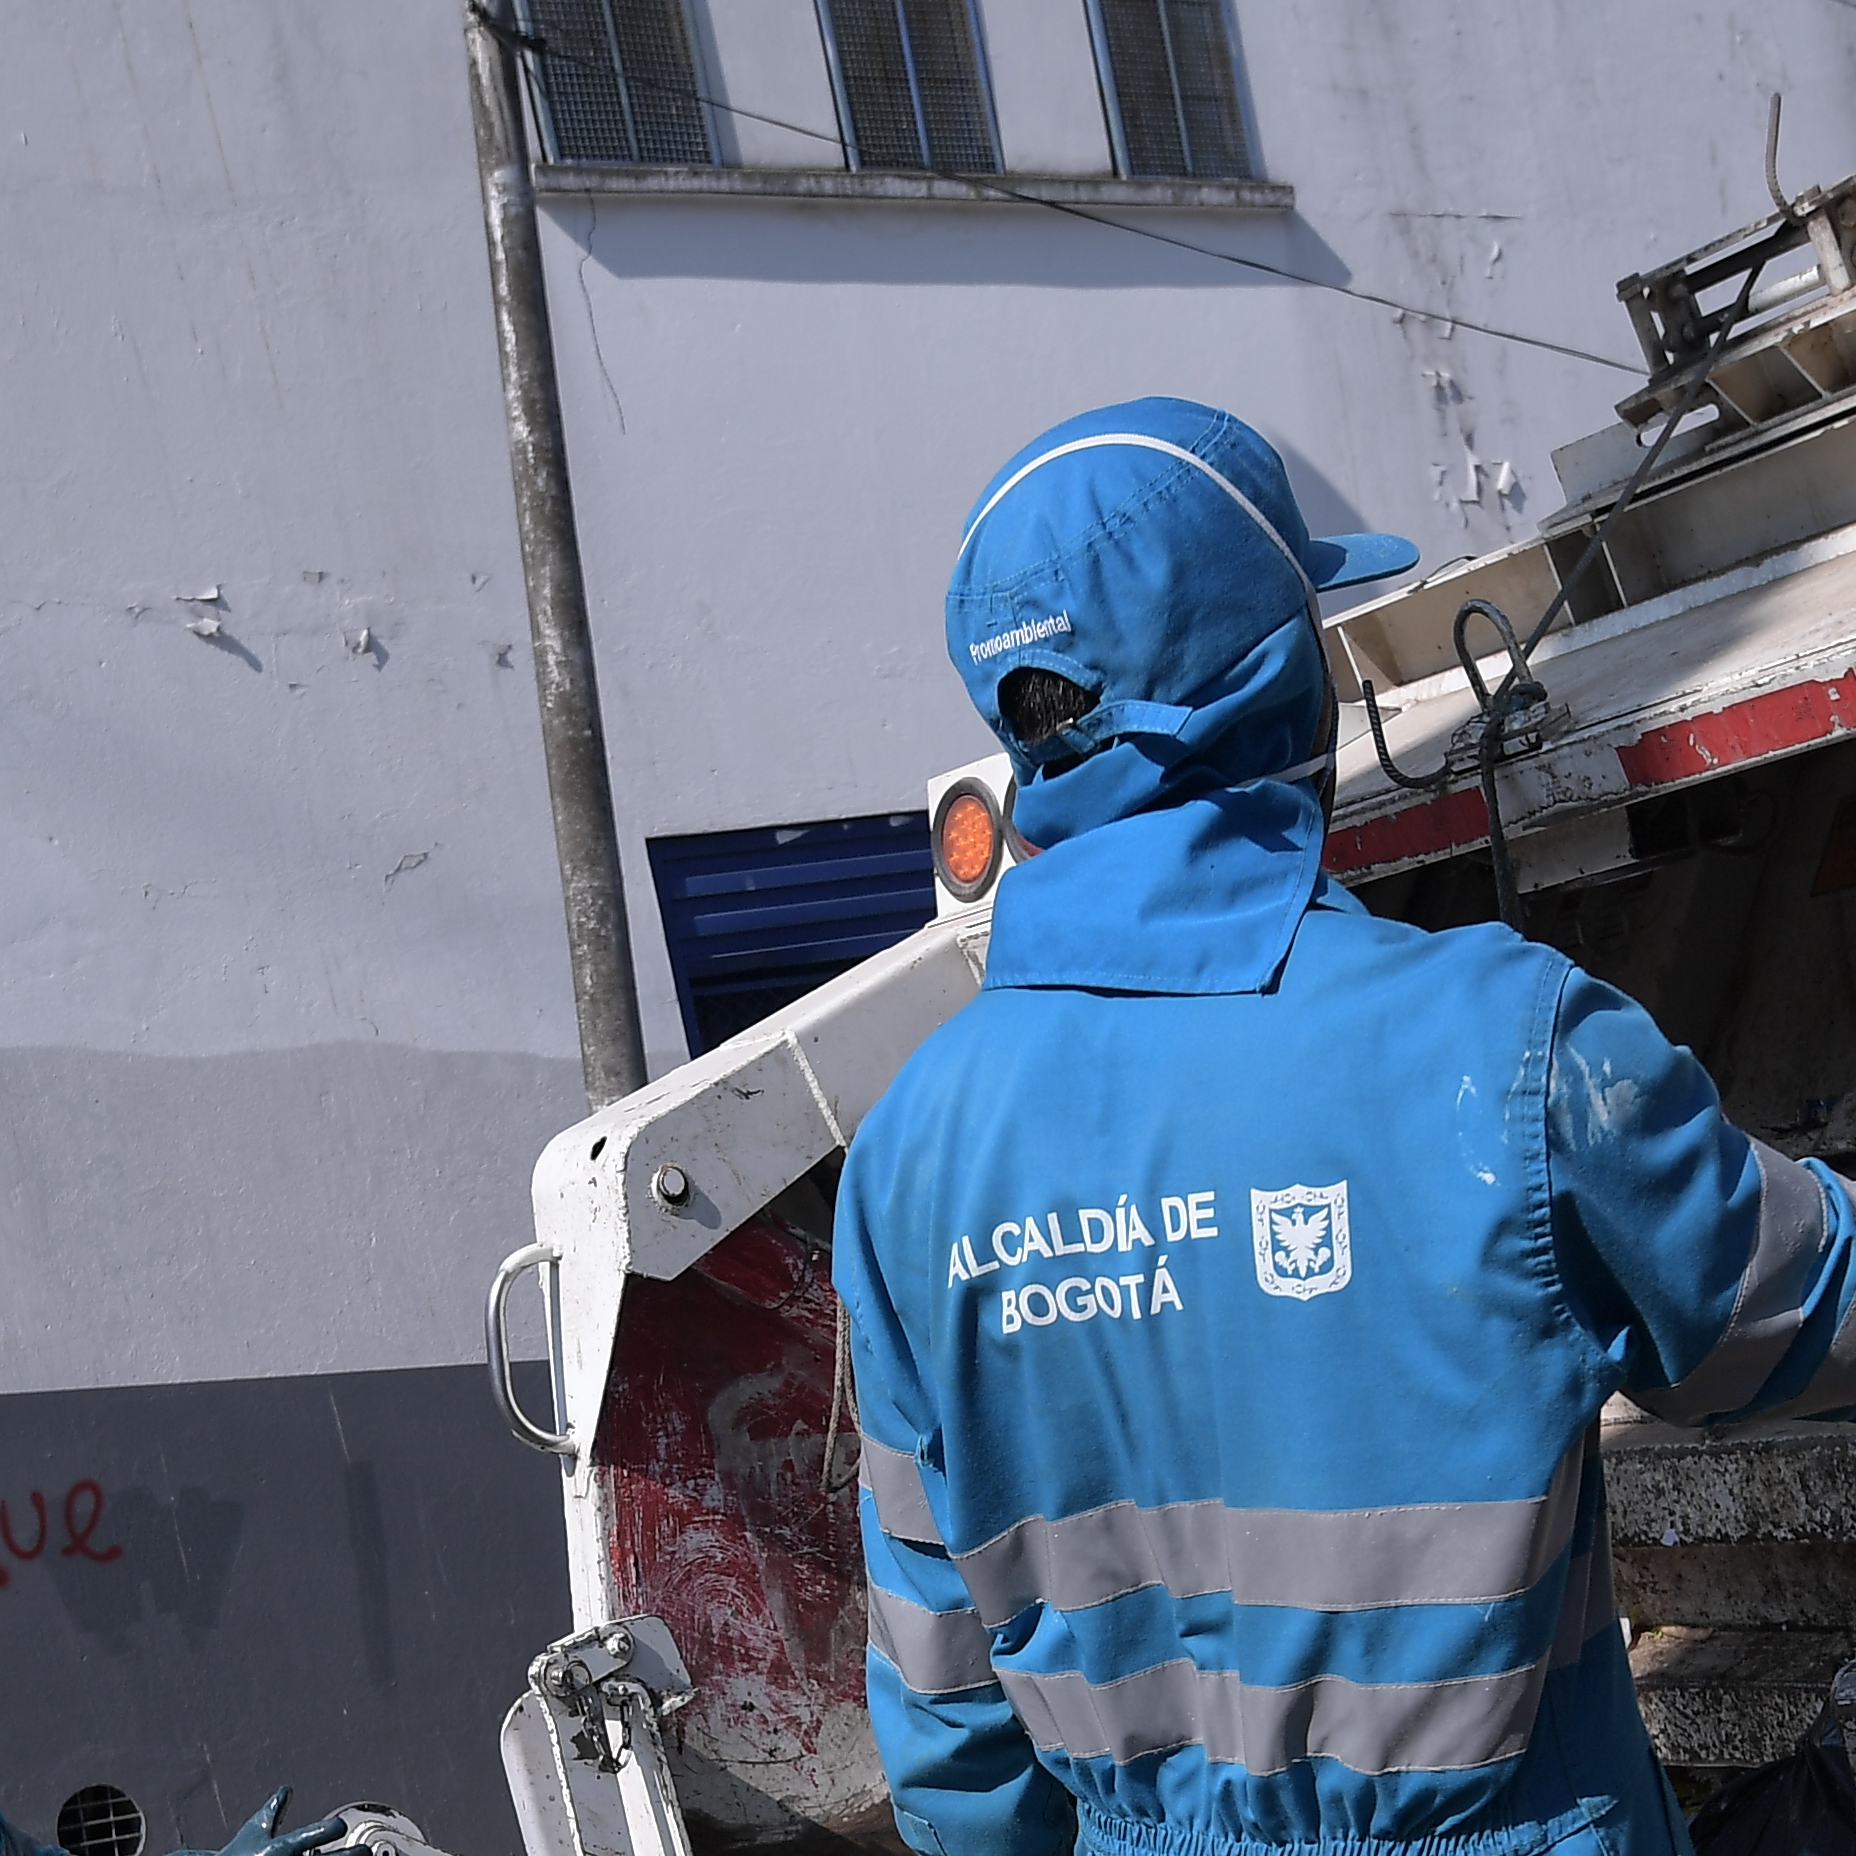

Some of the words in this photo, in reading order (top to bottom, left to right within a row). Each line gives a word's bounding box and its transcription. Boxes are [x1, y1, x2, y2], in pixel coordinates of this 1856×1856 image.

[969, 608, 1072, 666] Promoambiental
[947, 1193, 1156, 1288] ALCALDÍA
[1160, 1190, 1219, 1243] DE
[1001, 1254, 1184, 1335] BOGOTÁ
